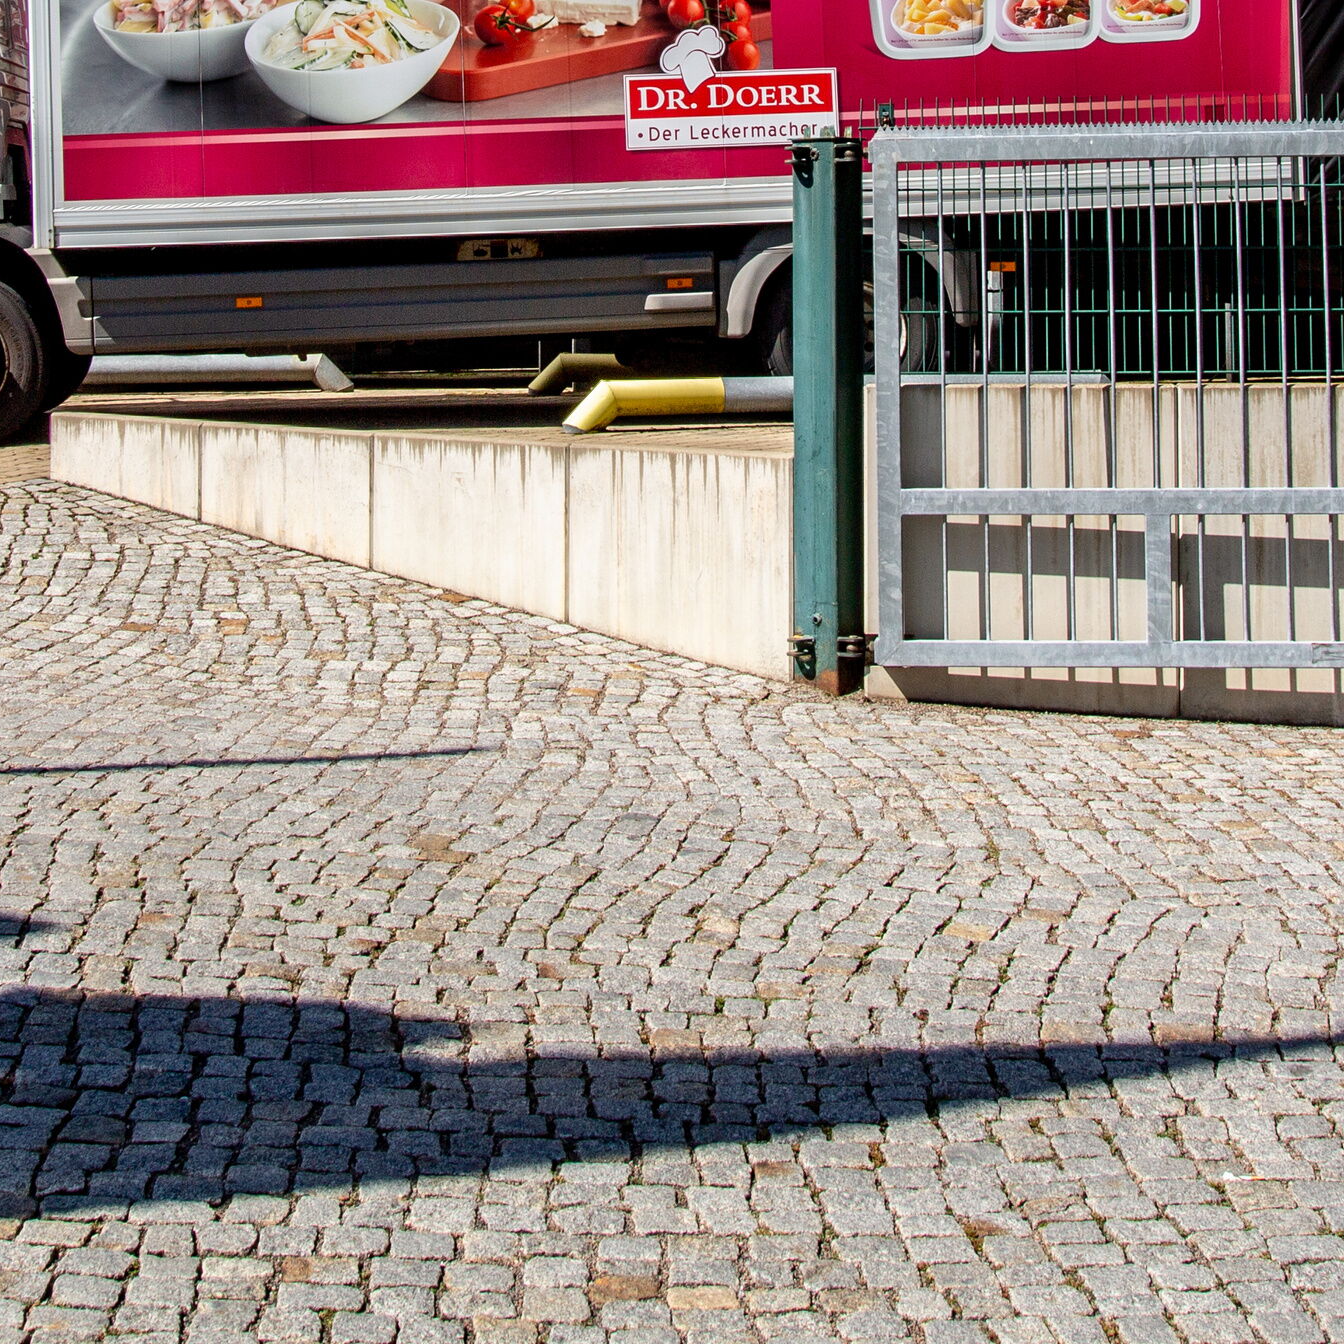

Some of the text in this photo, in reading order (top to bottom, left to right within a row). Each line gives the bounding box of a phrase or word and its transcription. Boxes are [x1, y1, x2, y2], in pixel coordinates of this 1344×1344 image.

[637, 84, 824, 111] DR. DOERR
[649, 122, 818, 142] Der Leckermacher
